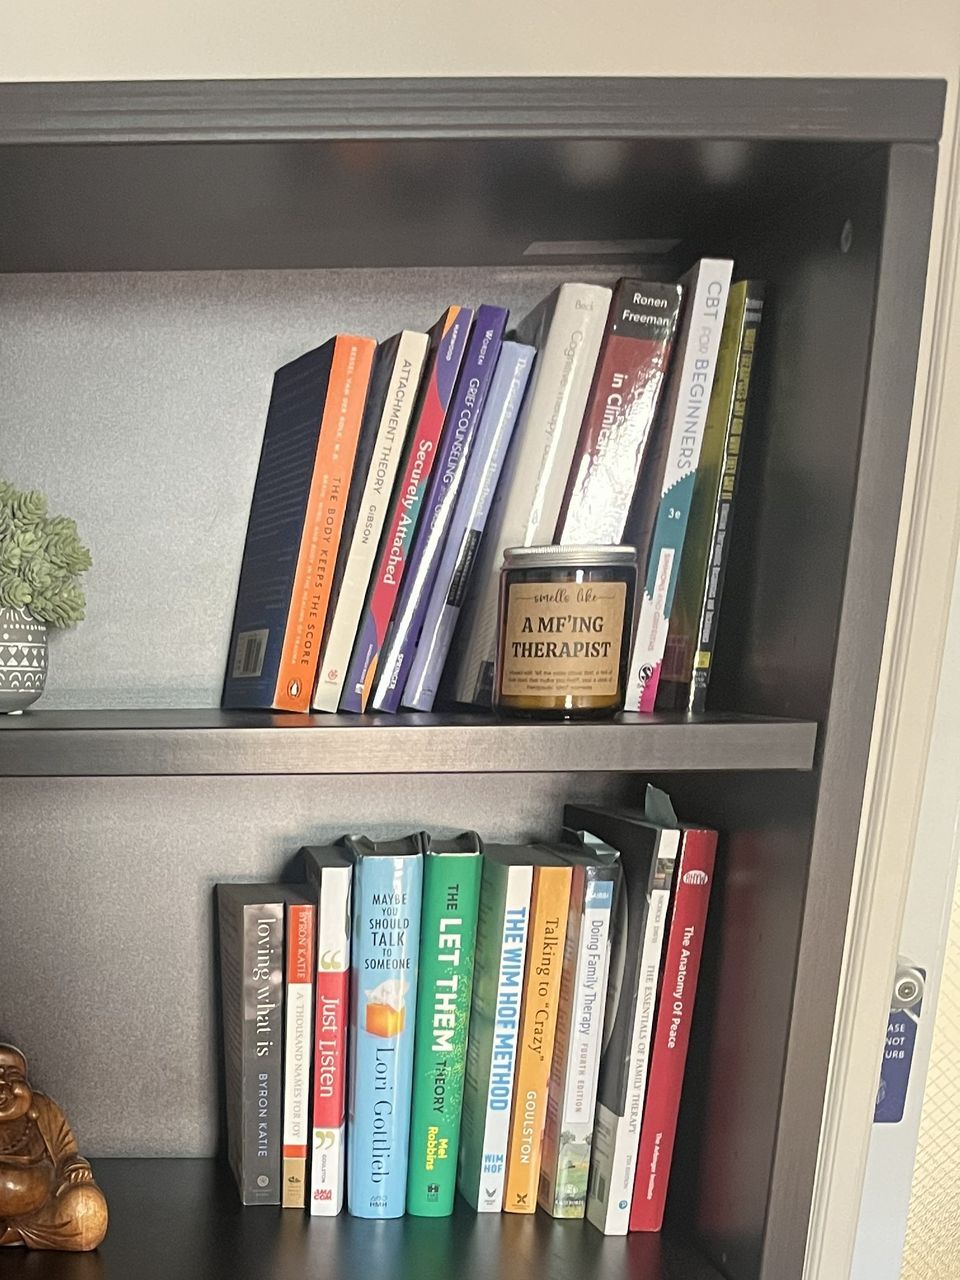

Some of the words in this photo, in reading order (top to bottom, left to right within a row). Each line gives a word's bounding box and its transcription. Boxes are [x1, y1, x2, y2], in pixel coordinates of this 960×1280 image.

[621, 309, 671, 327] Freeman
[632, 293, 668, 309] Ronen
[703, 281, 722, 320] CBT
[477, 329, 494, 366] WORDEN
[385, 360, 412, 443] ATTACHMENT
[676, 358, 709, 470] BEGINNERS
[442, 409, 472, 484] COUNSELING
[330, 476, 342, 501] THE
[372, 445, 392, 496] THEORY
[401, 440, 433, 510] Securely
[322, 508, 336, 543] BODY
[361, 504, 377, 545] GIBSON
[667, 507, 681, 520] 3e
[314, 549, 329, 588] KEEPS
[382, 512, 413, 586] Attached
[309, 594, 321, 618] THE
[534, 588, 570, 604] smells
[576, 588, 598, 603] like
[521, 616, 534, 633] A
[537, 615, 604, 633] MF'ING
[300, 624, 315, 667] SCORE
[511, 641, 612, 658] THERAPIST
[446, 883, 459, 911] THE
[369, 918, 410, 930] SHOULD
[371, 931, 405, 947] TALK
[437, 917, 463, 966] LET
[504, 906, 527, 944] THE
[586, 920, 604, 951] Doing
[682, 925, 695, 947] The
[251, 918, 277, 981] loving
[364, 958, 411, 970] SOMEONE
[535, 917, 560, 976] Talking
[500, 947, 522, 987] WIM
[583, 953, 601, 990] Family
[672, 948, 691, 999] Anatomy
[537, 981, 551, 997] to
[256, 985, 276, 1034] what
[320, 995, 339, 1032] Just
[431, 974, 458, 1052] THEM
[496, 992, 519, 1030] HOF
[579, 991, 597, 1036] Therapy
[256, 1040, 274, 1057] is
[293, 1004, 305, 1062] THOUSAND
[667, 1017, 681, 1050] Peace
[318, 1039, 337, 1097] Listen
[374, 1047, 394, 1090] Lori
[489, 1033, 515, 1112] METHOD
[258, 1073, 268, 1118] BYRON
[258, 1122, 268, 1157] KATIE
[370, 1100, 393, 1184] Gottlieb
[518, 1090, 537, 1165] GOULSTON
[425, 1126, 439, 1171] Robbins
